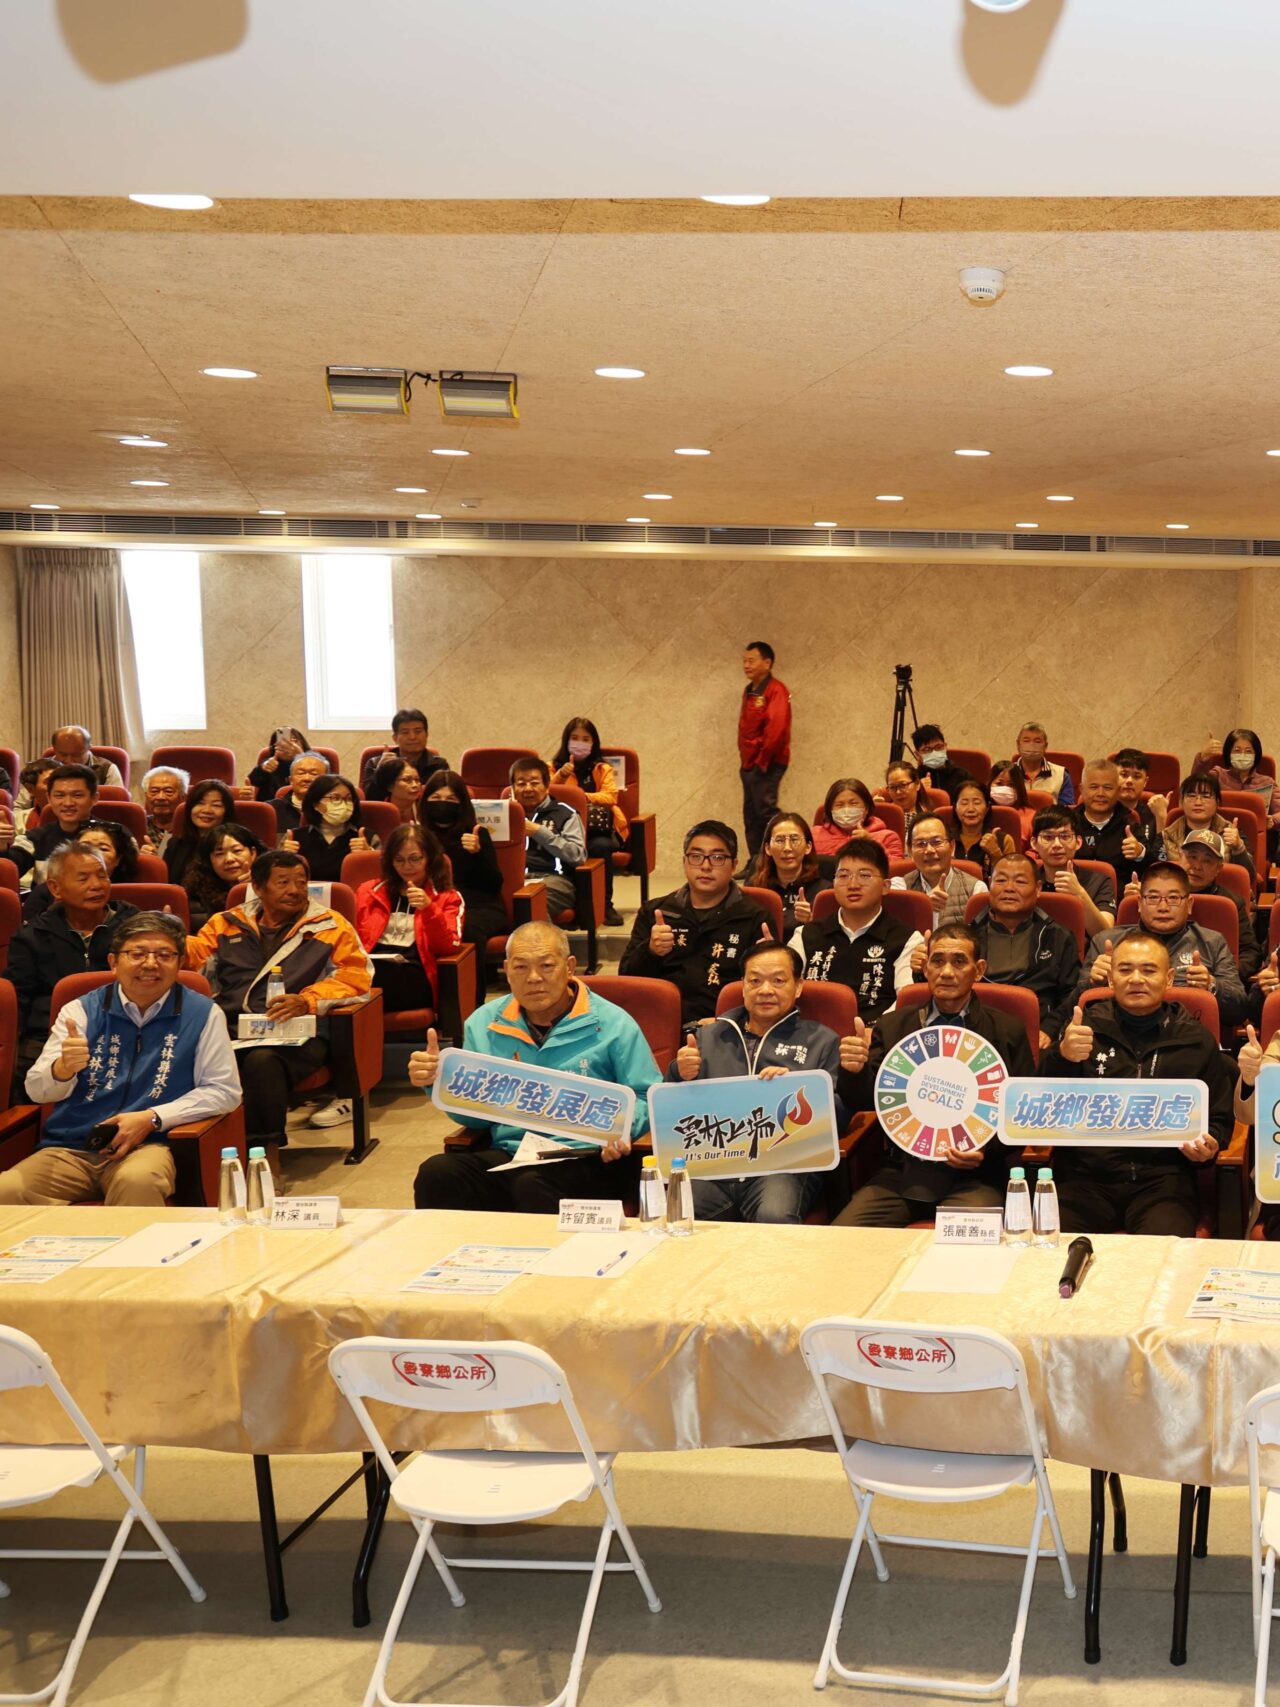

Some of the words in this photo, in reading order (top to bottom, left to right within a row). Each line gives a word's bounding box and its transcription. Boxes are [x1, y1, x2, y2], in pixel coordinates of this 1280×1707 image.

[149, 1033, 178, 1099] 雲林縣政府
[921, 1081, 966, 1099] DEVELOPMENT
[923, 1074, 968, 1092] SUSTAINABLE
[447, 1065, 620, 1130] 城鄉發展處
[917, 1087, 964, 1111] GOALS
[1014, 1093, 1193, 1129] 城鄉發展處
[673, 1106, 776, 1160] 雲林上場
[685, 1152, 702, 1161] It's
[705, 1151, 722, 1160] Our
[723, 1149, 745, 1159] Time
[867, 1343, 948, 1363] 麥寮鄉公所
[403, 1361, 487, 1380] 麥寮鄉公所
